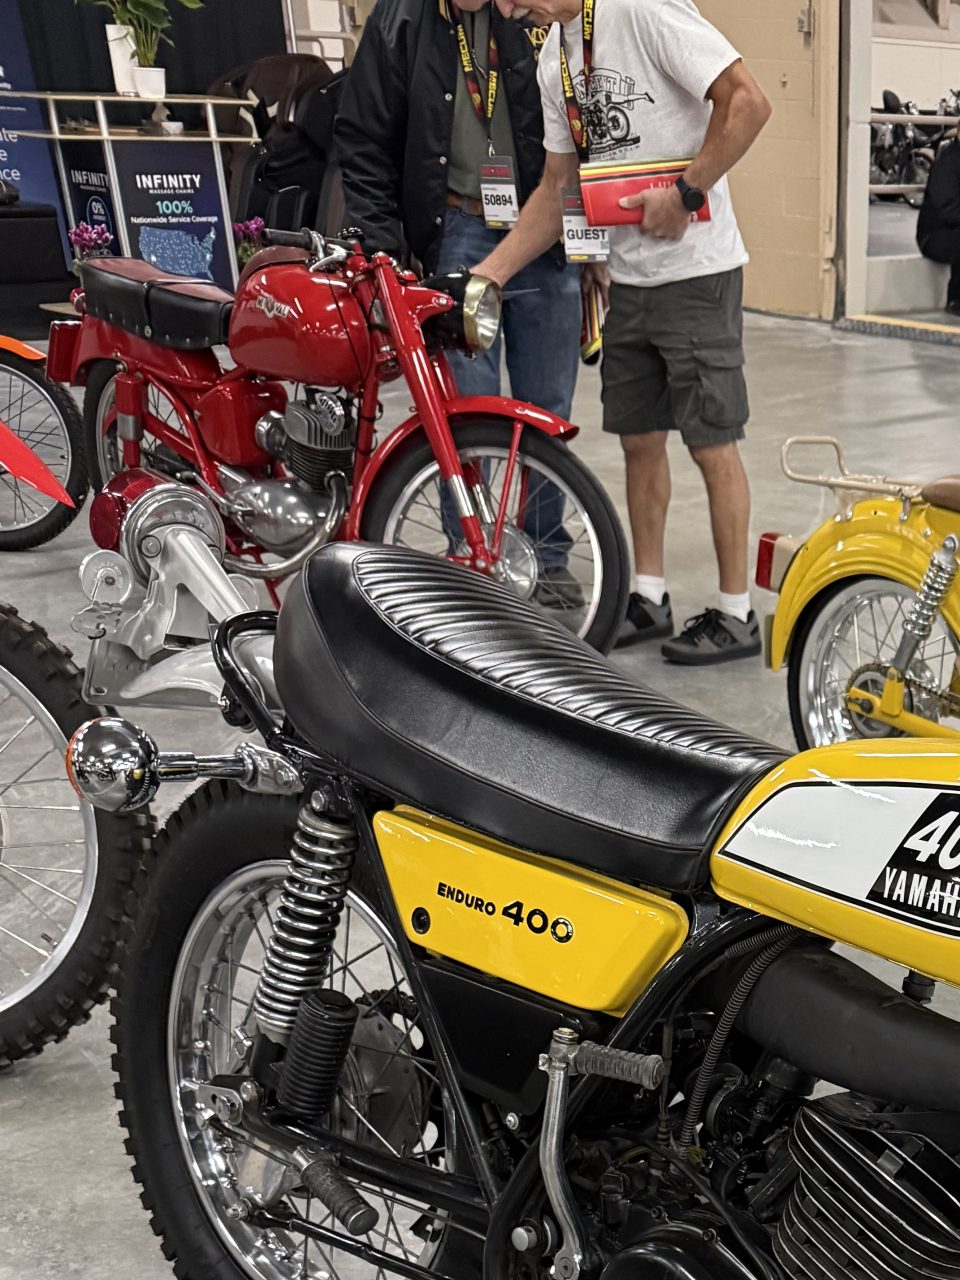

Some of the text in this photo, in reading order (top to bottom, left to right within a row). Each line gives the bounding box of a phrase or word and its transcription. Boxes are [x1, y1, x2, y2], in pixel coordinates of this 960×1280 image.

[583, 0, 594, 41] ECUM
[457, 24, 473, 73] MECUM
[487, 70, 498, 118] MECUM
[135, 174, 201, 189] INFINITY
[155, 200, 194, 214] 100%
[484, 193, 513, 207] 50894
[130, 216, 168, 224] Nationwide
[191, 215, 218, 224] Coverage
[566, 228, 607, 241] GUEST
[436, 881, 574, 943] ENDURO 400
